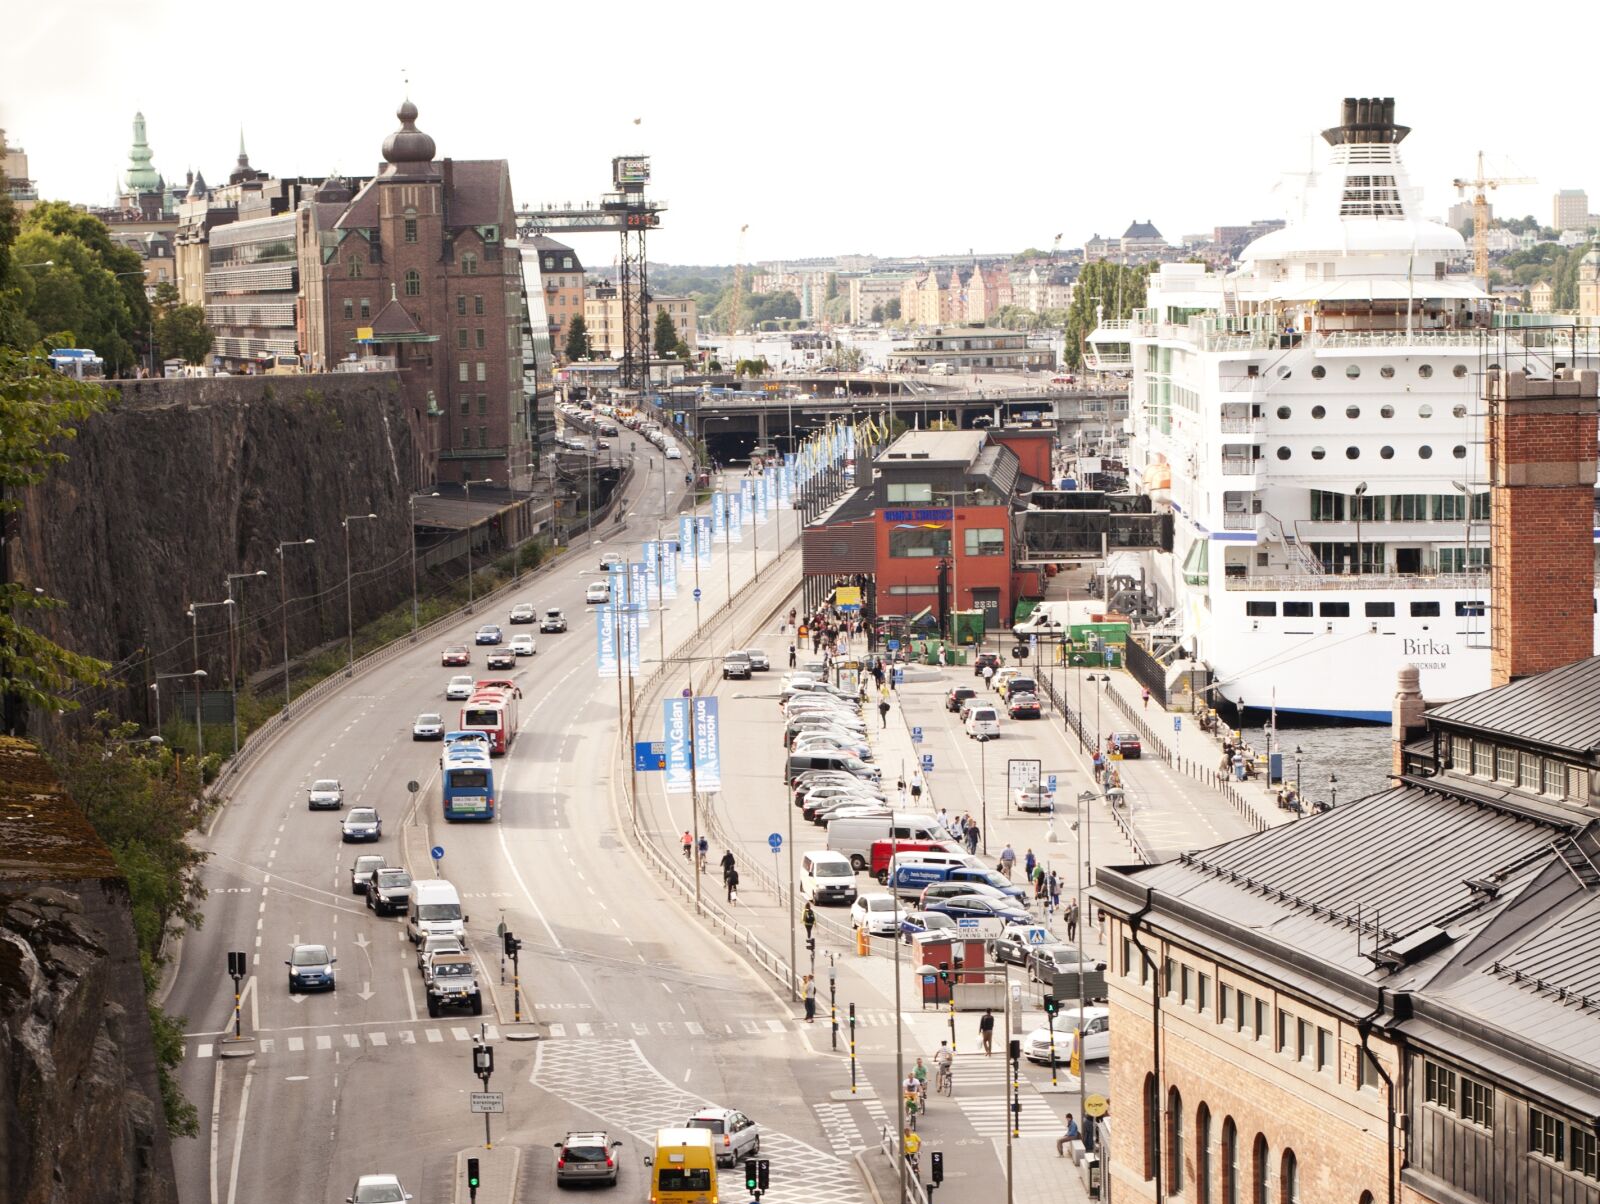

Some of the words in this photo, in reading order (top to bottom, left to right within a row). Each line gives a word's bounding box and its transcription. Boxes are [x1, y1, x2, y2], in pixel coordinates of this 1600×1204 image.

[628, 215, 640, 225] 23
[1403, 638, 1451, 655] Birka
[697, 700, 706, 724] AUG
[698, 723, 706, 736] 22
[706, 715, 717, 760] STADION
[698, 739, 708, 760] TOR
